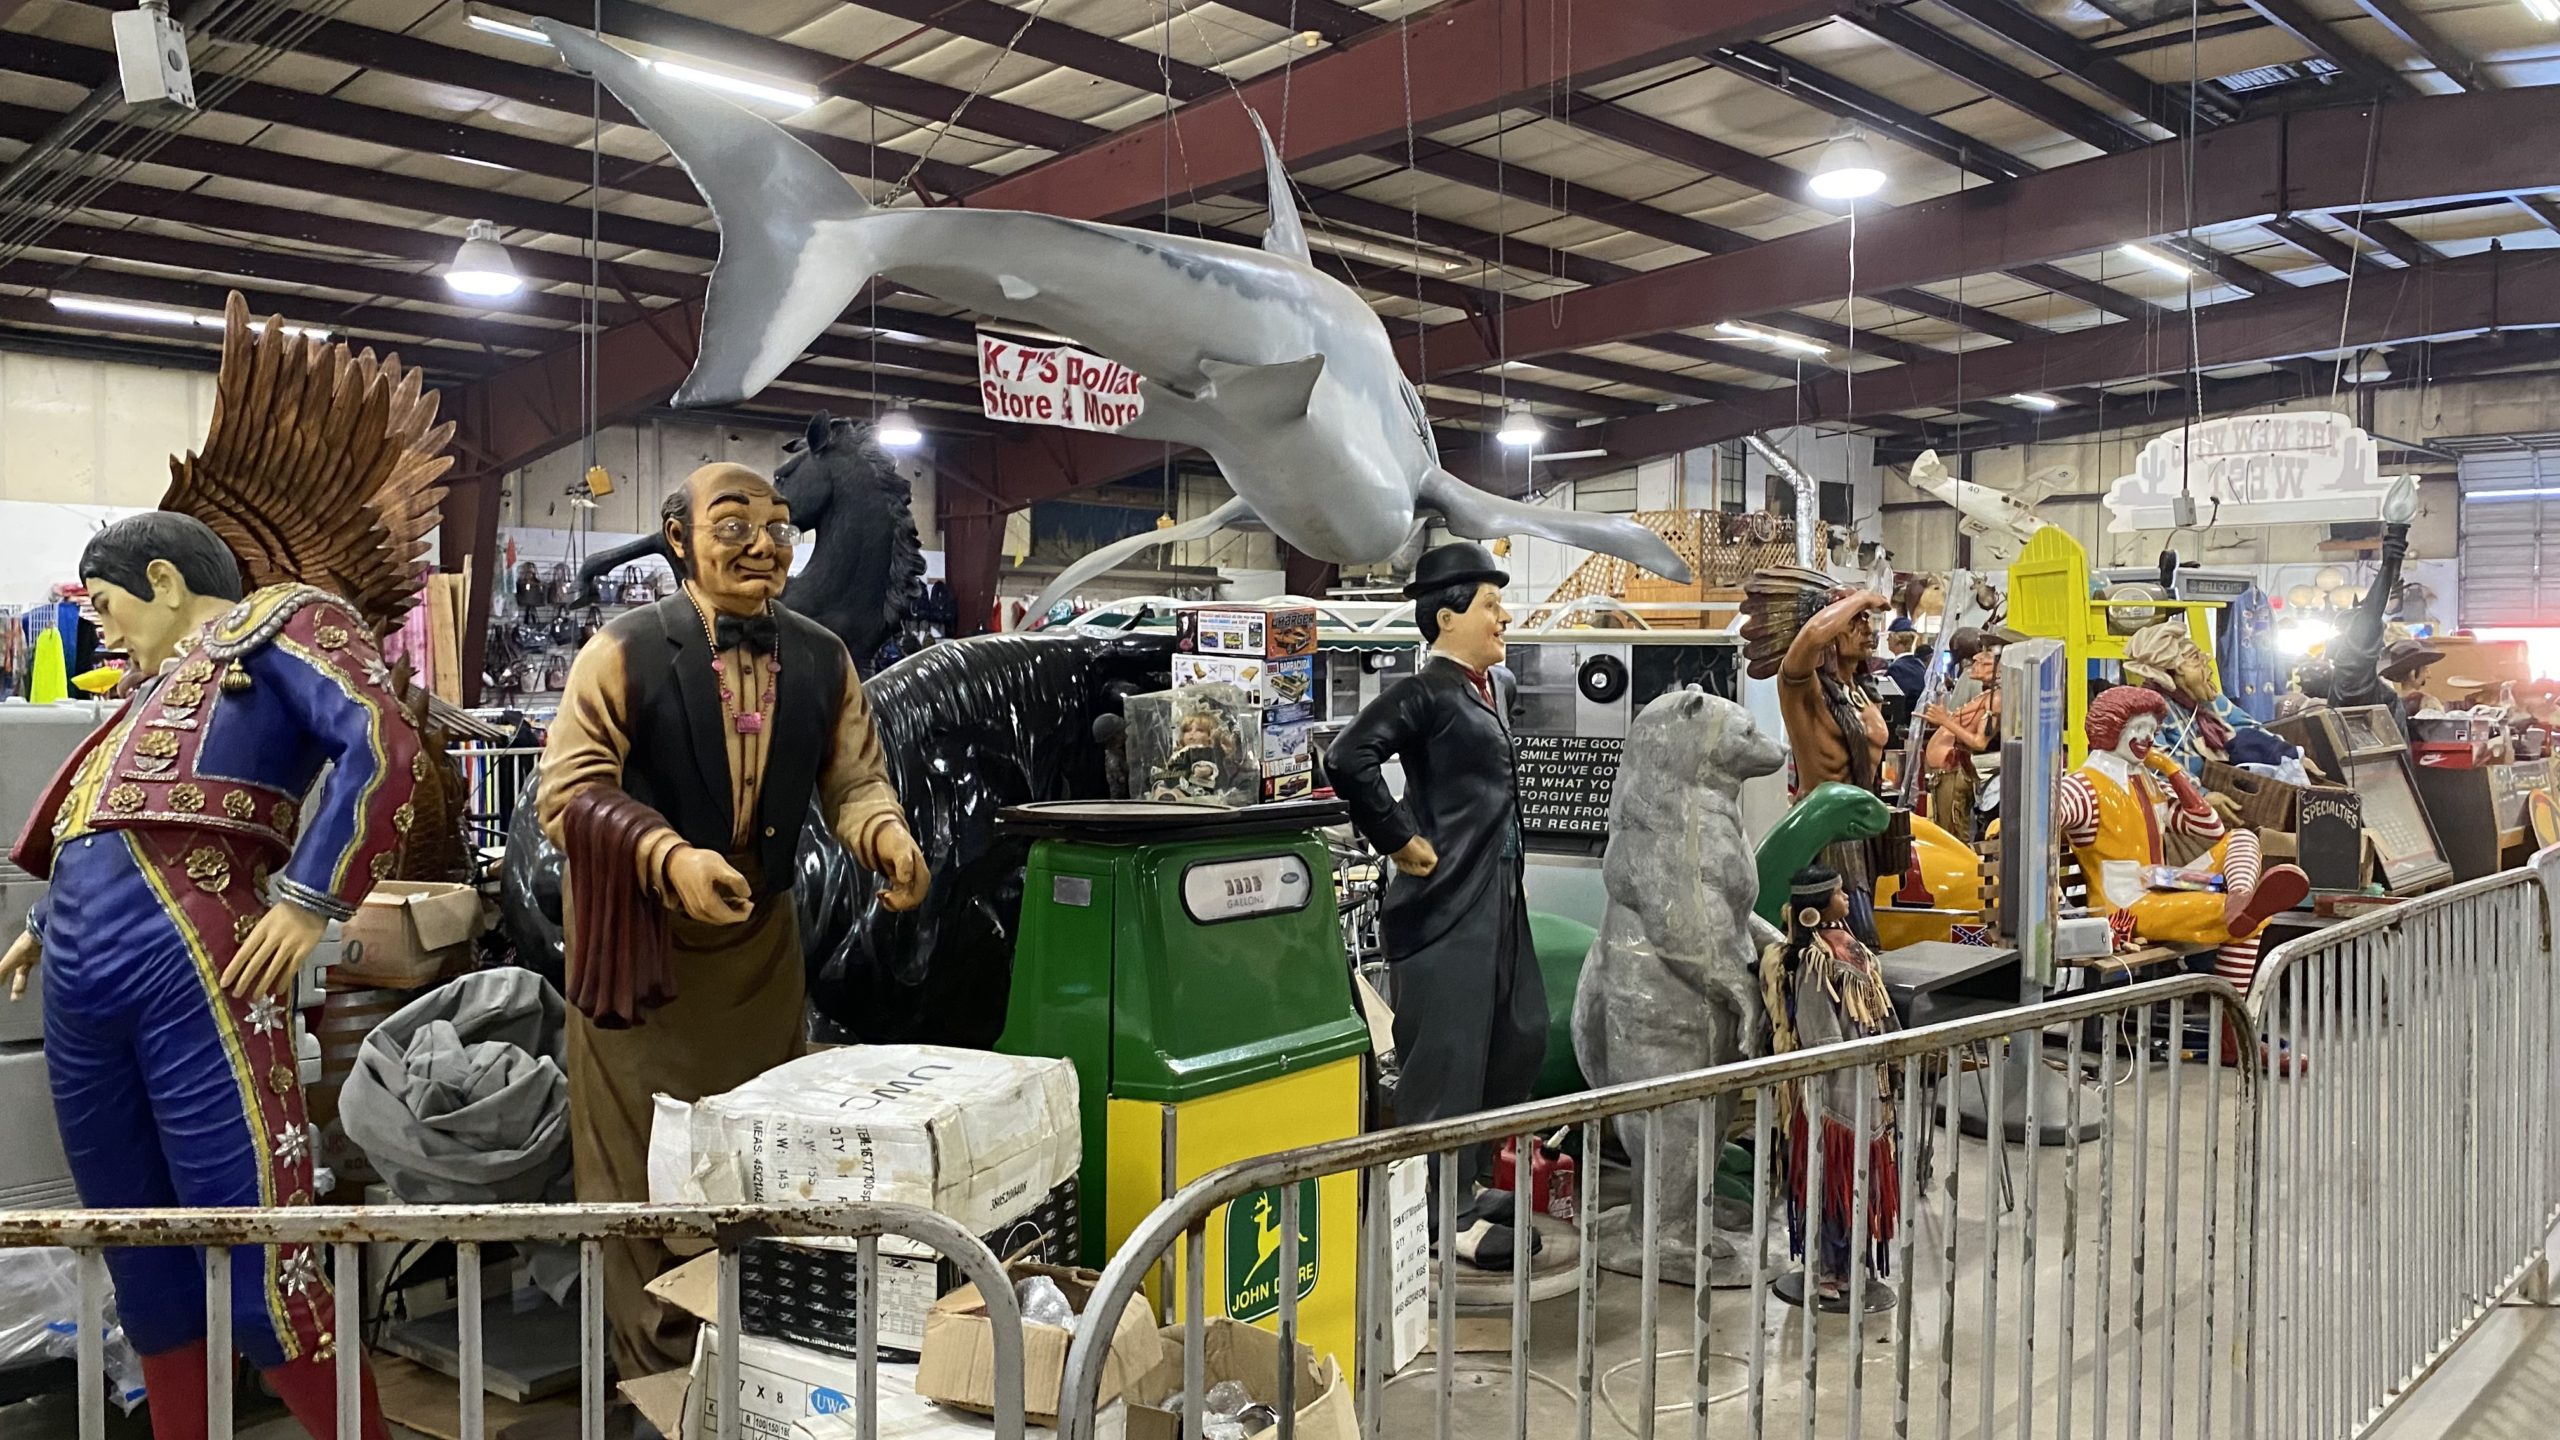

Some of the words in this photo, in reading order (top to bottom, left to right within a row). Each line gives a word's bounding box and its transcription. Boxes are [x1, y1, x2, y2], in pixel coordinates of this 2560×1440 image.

[1067, 356, 1140, 395] Dollar
[983, 380, 1052, 420] Store
[1061, 387, 1073, 421] &
[1084, 391, 1138, 426] More
[1968, 485, 1980, 494] 40
[1513, 737, 1522, 746] O
[1526, 737, 1558, 748] TAKE
[1562, 738, 1587, 748] THE
[1520, 750, 1560, 761] SMILE
[1563, 752, 1597, 762] WITH
[1518, 763, 1535, 773] AT
[1539, 764, 1588, 775] YOU'VE
[1519, 777, 1536, 787] ER
[1542, 777, 1584, 788] WHAT
[1590, 779, 1610, 790] YO
[1520, 790, 1584, 802] FORGIVE
[1589, 793, 1609, 803] BU
[1523, 804, 1570, 815] LEARN
[2302, 800, 2358, 829] SPECIALTIES
[1523, 818, 1541, 828] ER
[1227, 896, 1264, 909] GALLONS
[753, 1120, 763, 1157] MEAS:
[829, 1127, 845, 1152] QTY
[1232, 1281, 1269, 1312] JOHN
[1274, 1262, 1314, 1294] DRE
[756, 1385, 765, 1399] X
[776, 1392, 783, 1404] 8
[755, 1417, 766, 1429] 100
[768, 1421, 779, 1433] 150
